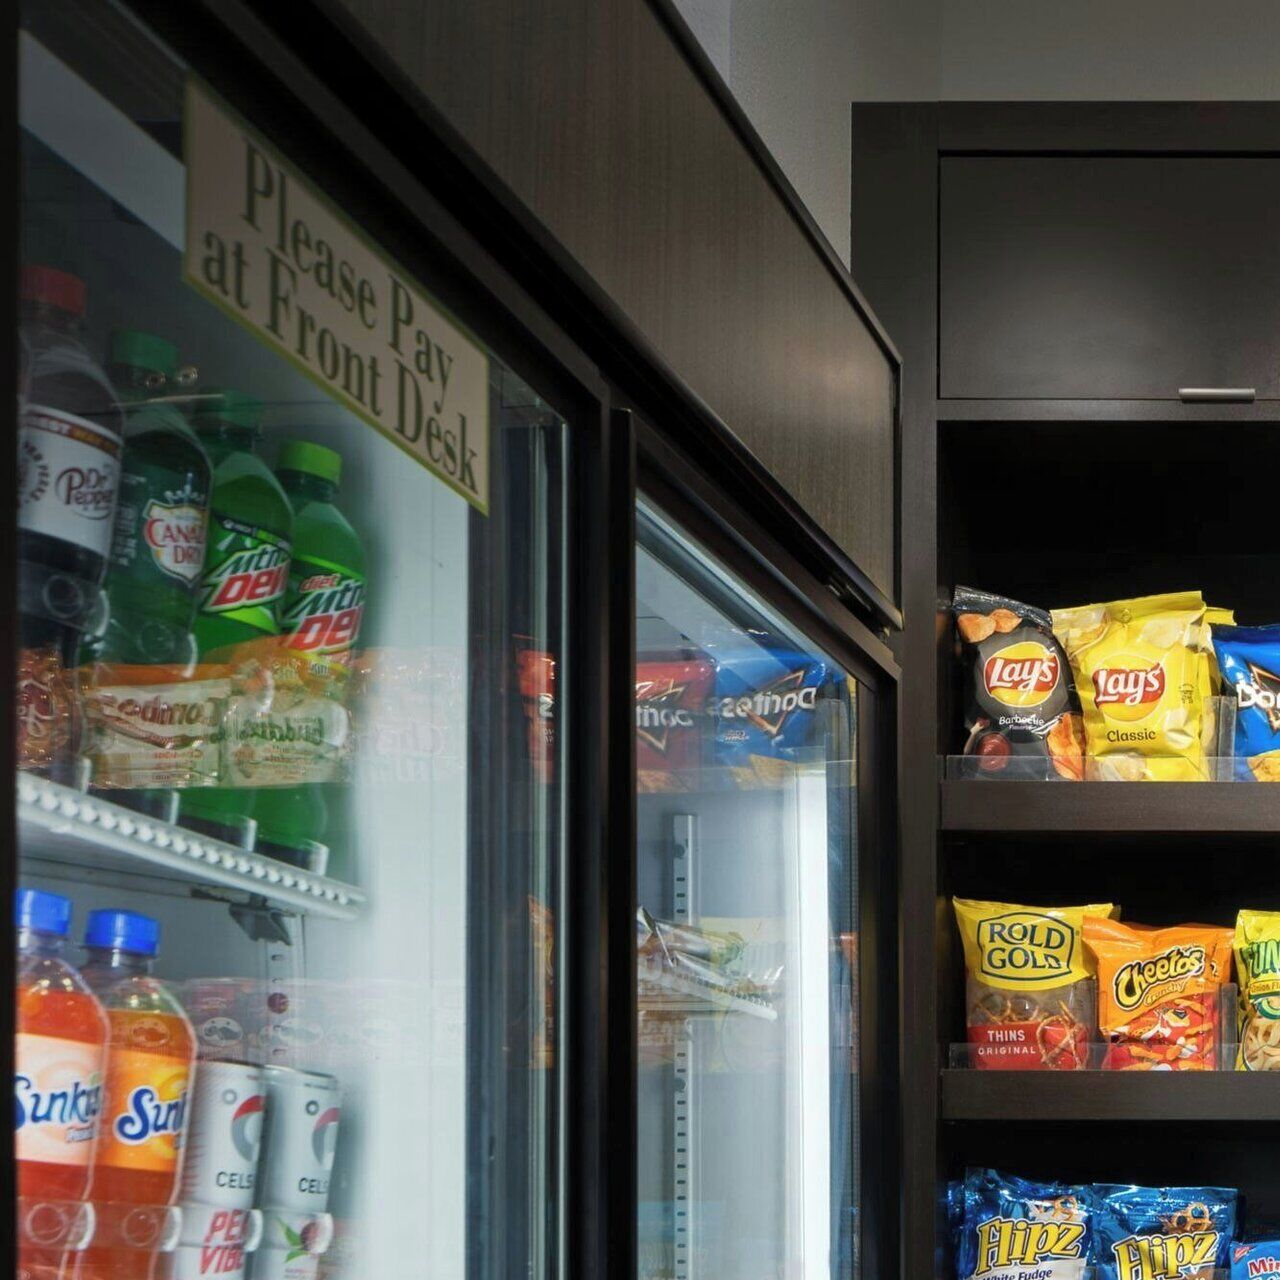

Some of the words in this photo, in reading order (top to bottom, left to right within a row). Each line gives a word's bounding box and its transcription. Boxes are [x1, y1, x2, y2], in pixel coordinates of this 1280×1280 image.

[240, 139, 378, 332] Please
[388, 273, 455, 413] Pay
[204, 230, 250, 310] at
[264, 247, 384, 417] Front
[394, 359, 480, 496] Desk
[302, 573, 342, 592] diet
[990, 654, 1059, 696] Lay's
[1094, 662, 1162, 706] Lay's
[1107, 727, 1157, 743] Classic
[988, 922, 1066, 950] ROLD
[986, 946, 1062, 970] GOLD
[1115, 945, 1205, 1010] Cheetos
[978, 1044, 1037, 1056] ORIGINAL
[988, 1030, 1026, 1042] THINS
[975, 1216, 1086, 1277] Flipz
